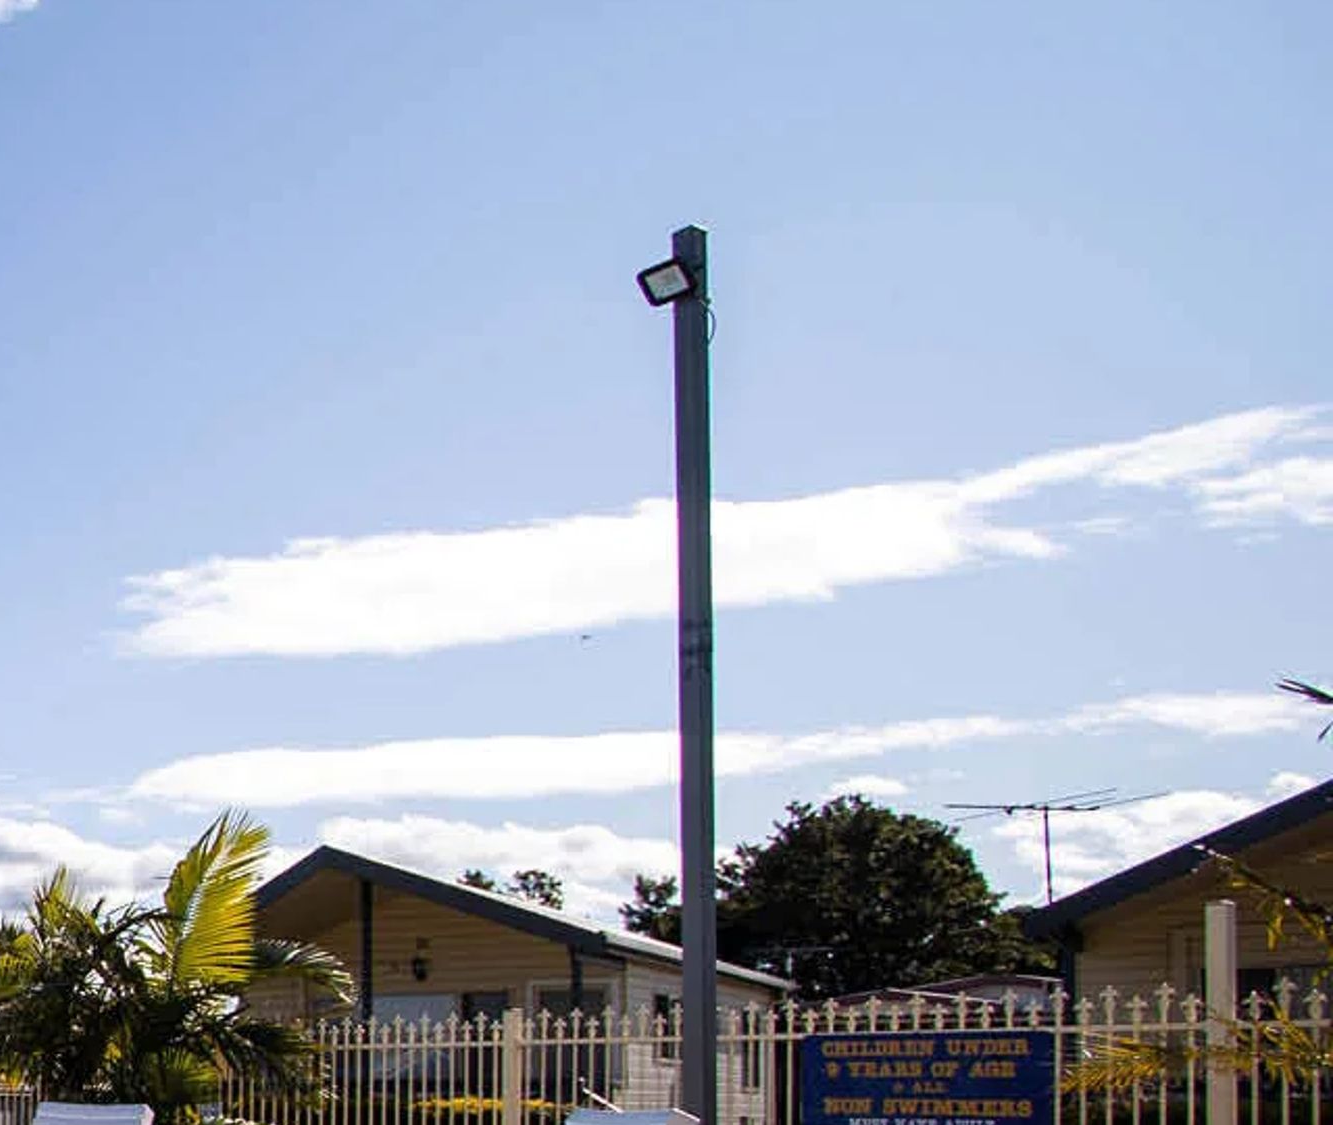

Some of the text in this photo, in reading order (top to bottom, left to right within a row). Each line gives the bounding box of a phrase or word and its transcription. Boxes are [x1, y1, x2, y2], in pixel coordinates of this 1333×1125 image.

[848, 1061, 923, 1078] YEARS
[931, 1061, 960, 1078] OF
[968, 1061, 1017, 1078] AGE
[913, 1081, 948, 1093] ALL
[823, 1098, 1033, 1117] NON SWIMMERS
